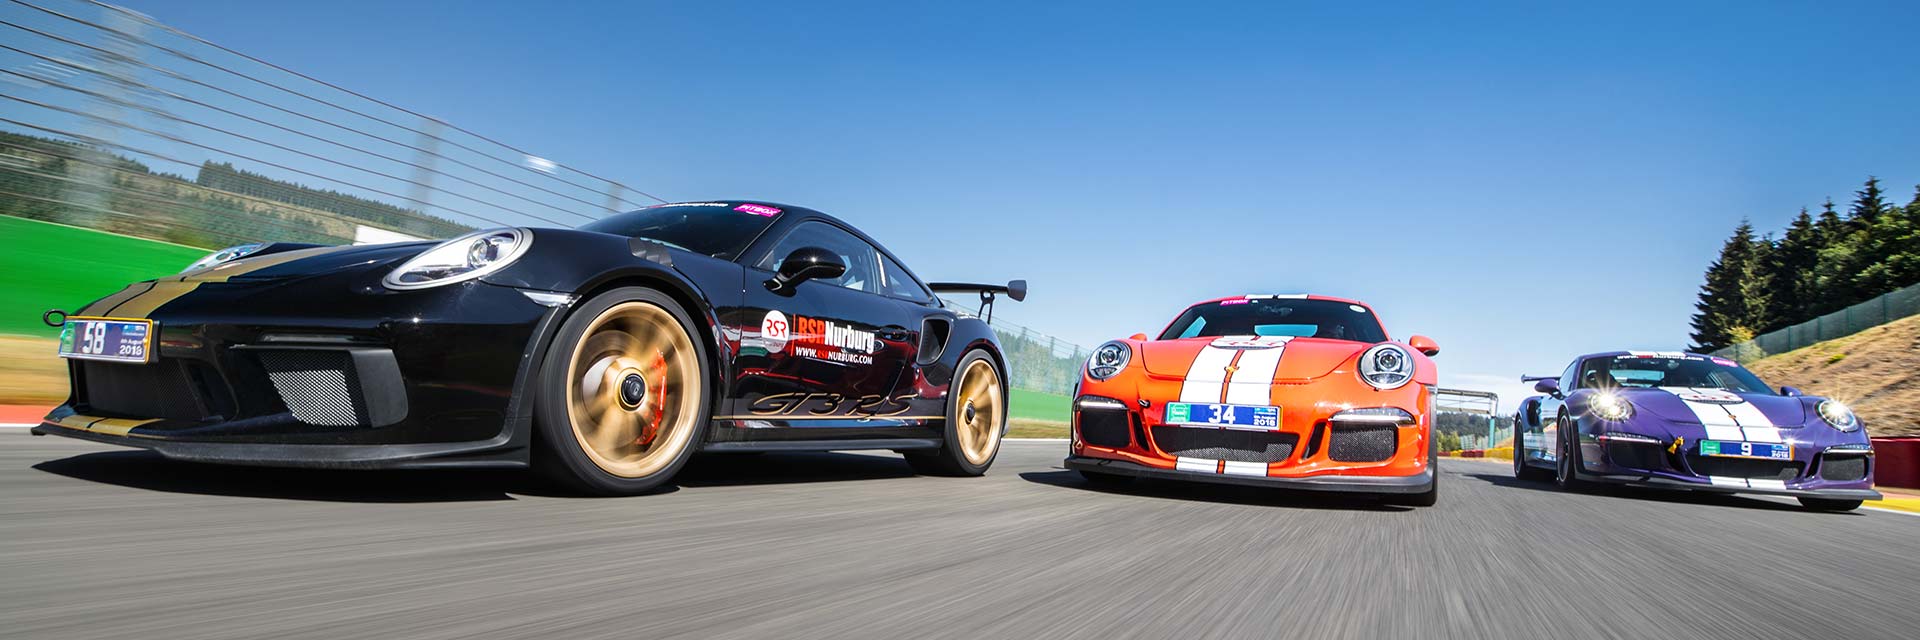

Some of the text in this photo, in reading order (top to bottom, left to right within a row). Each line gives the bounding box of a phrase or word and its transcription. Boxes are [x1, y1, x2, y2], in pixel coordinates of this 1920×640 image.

[737, 203, 778, 216] PITBOX
[766, 318, 787, 338] RSR
[82, 321, 107, 354] 58
[119, 344, 143, 356] 2018
[749, 392, 845, 415] GT3
[1208, 403, 1236, 425] 34
[1252, 418, 1276, 427] 2018
[1741, 442, 1752, 456] 9
